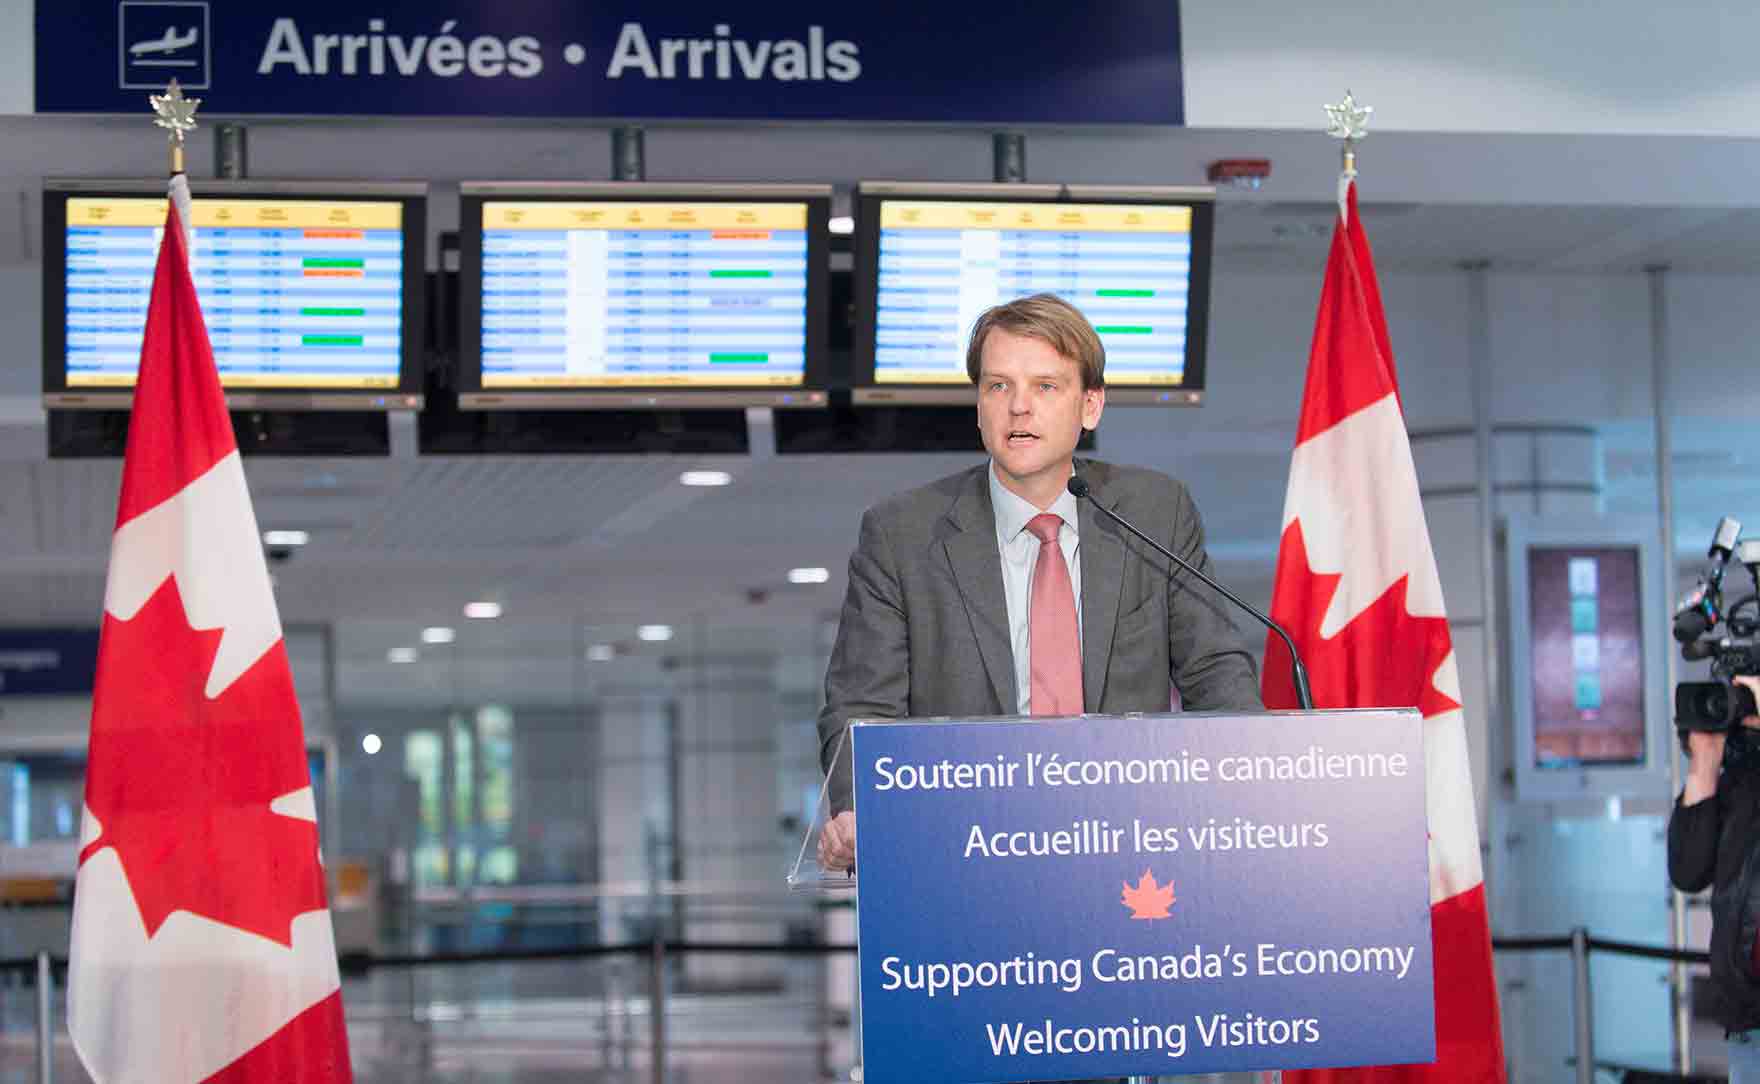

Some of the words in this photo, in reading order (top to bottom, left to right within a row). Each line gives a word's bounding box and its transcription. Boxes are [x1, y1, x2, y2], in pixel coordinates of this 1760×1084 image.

[258, 17, 543, 78] Arrivées
[607, 24, 861, 82] Arrivals
[875, 755, 1019, 791] Soutenir
[1026, 751, 1210, 787] l’économie
[1218, 746, 1408, 782] canadienne
[964, 820, 1125, 858] Accueillir
[1133, 820, 1179, 853] les
[1187, 817, 1330, 852] visiteurs
[880, 952, 1082, 997] Supporting
[1092, 945, 1248, 983] Canada’s
[1257, 943, 1415, 980] Economy
[985, 1019, 1187, 1059] Welcoming
[1194, 1013, 1320, 1049] Visitors
